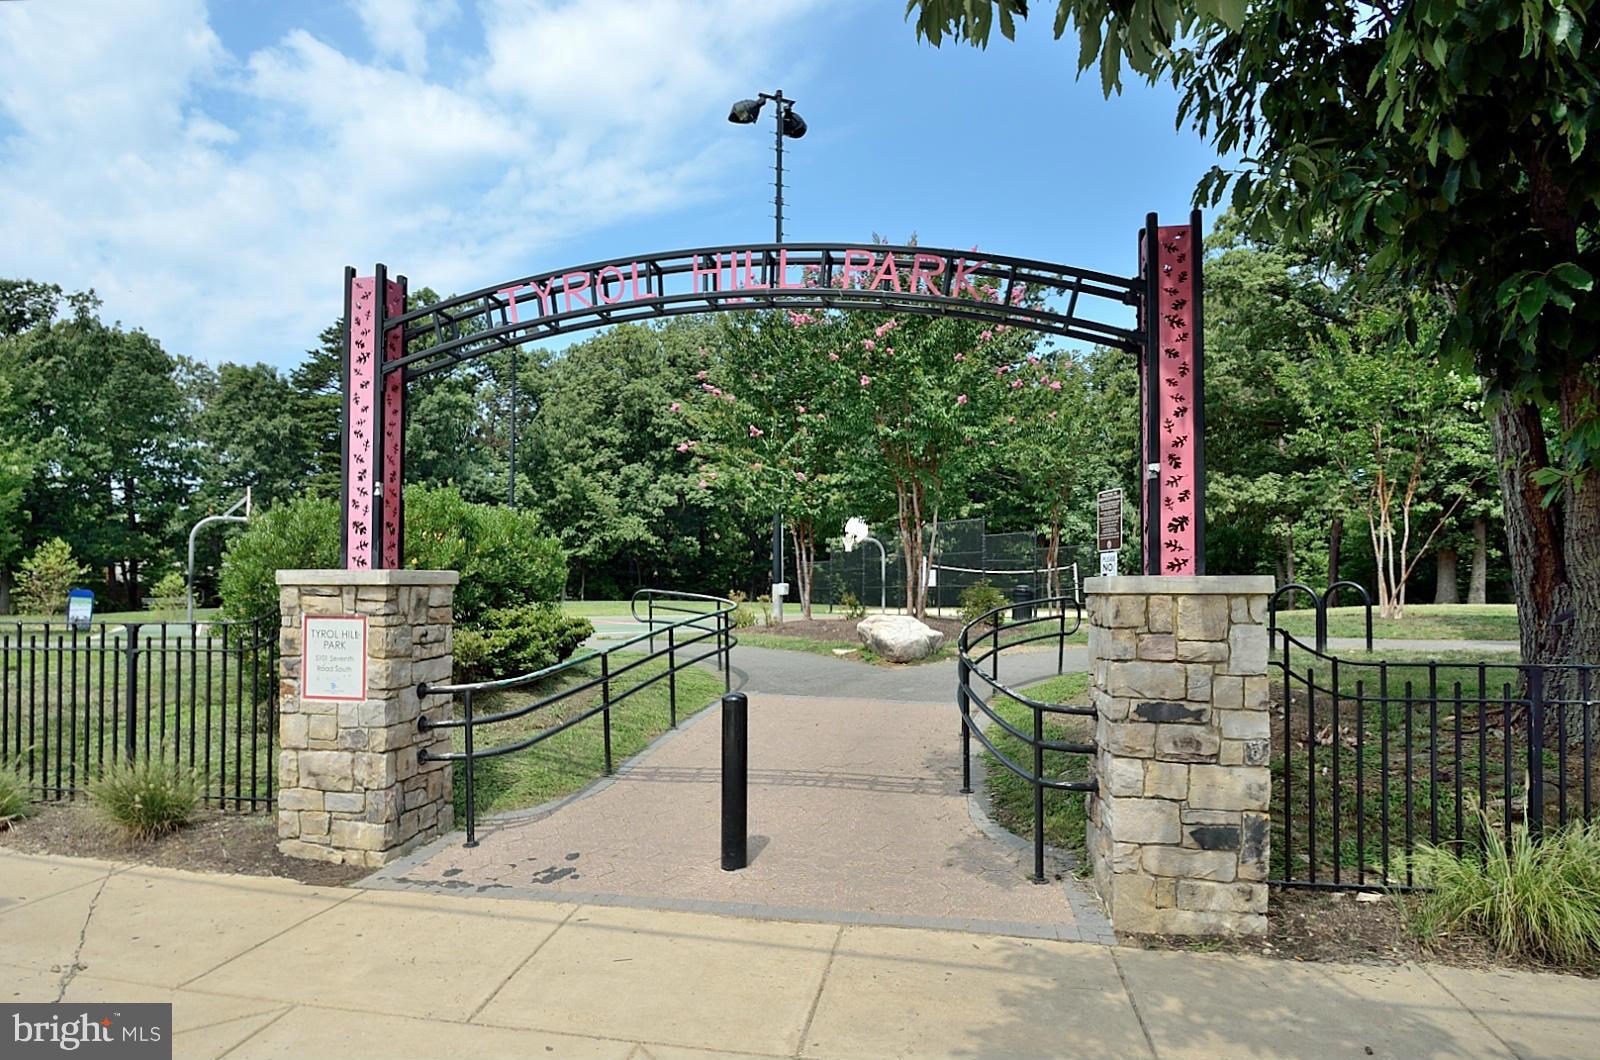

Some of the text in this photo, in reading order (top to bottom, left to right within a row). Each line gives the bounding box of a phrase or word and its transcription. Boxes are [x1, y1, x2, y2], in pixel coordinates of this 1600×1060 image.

[497, 248, 988, 324] TYROL HILL PARK
[311, 629, 359, 640] TYROL HILL
[323, 640, 346, 649] PARK
[316, 664, 352, 673] Road South
